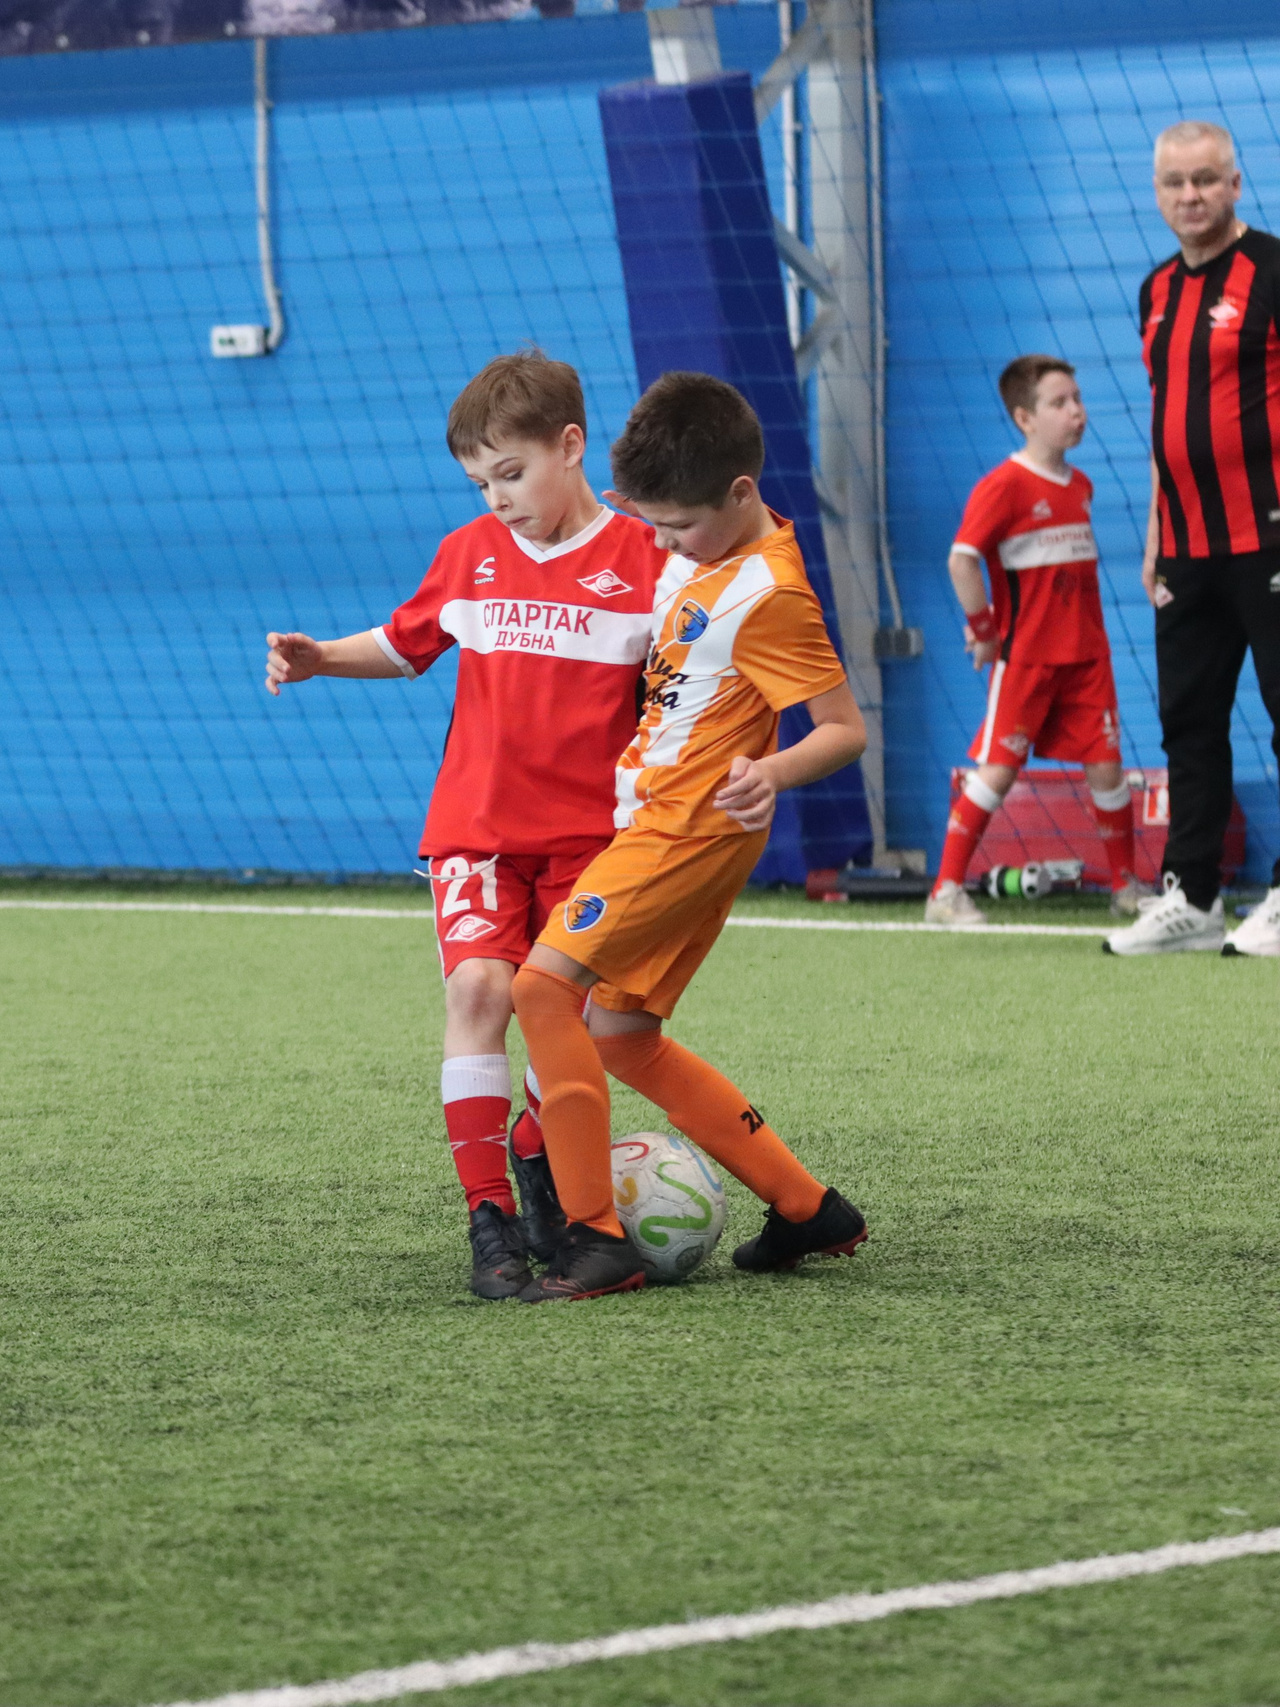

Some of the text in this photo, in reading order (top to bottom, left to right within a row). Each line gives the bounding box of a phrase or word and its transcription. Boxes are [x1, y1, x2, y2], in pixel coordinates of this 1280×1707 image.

[483, 602, 594, 636] СПАРТАК
[494, 630, 556, 652] ДУБНА
[440, 857, 498, 918] 21
